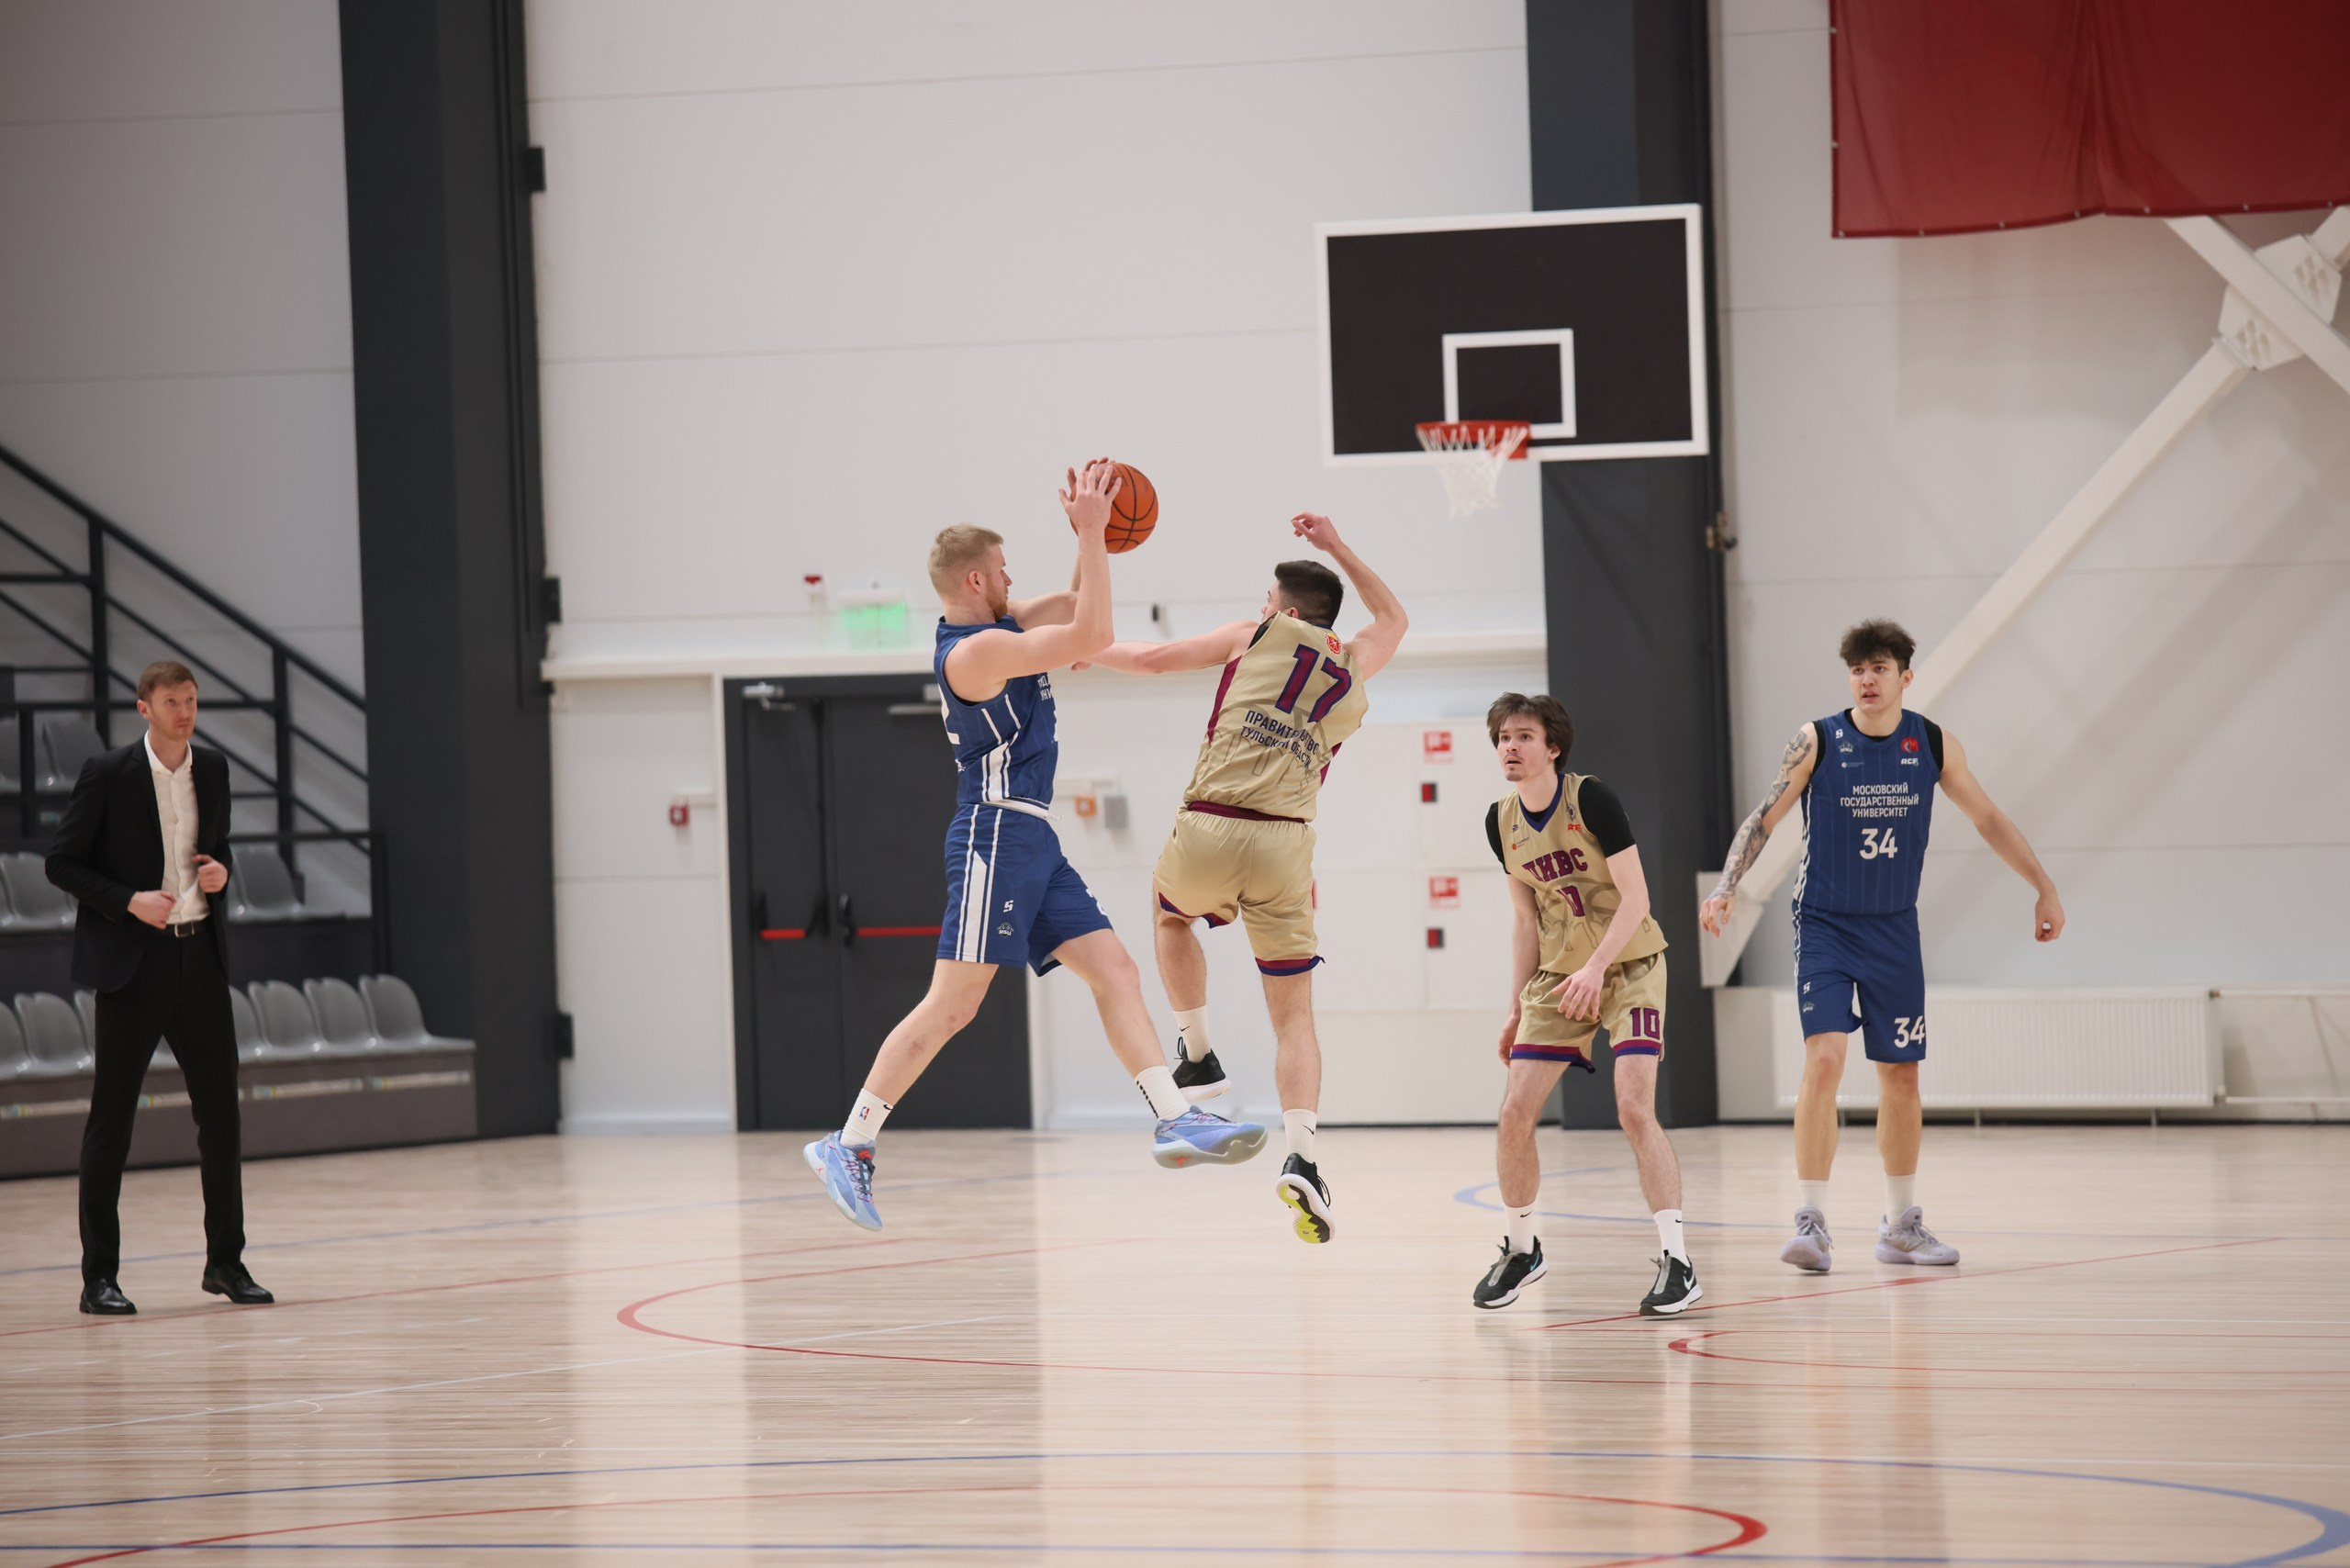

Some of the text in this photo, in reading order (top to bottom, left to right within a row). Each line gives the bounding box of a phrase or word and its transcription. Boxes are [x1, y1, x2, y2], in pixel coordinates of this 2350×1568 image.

[1274, 643, 1352, 723] 17
[1840, 793, 1919, 807] ГОСУДАРСТВЕННЫЙ
[1852, 781, 1908, 796] МОСКОВСКИЙ
[1852, 807, 1908, 818] УНИВЕРСИТЕТ
[1859, 827, 1898, 860] 34
[1629, 1007, 1661, 1040] 10
[1894, 1015, 1925, 1048] 34
